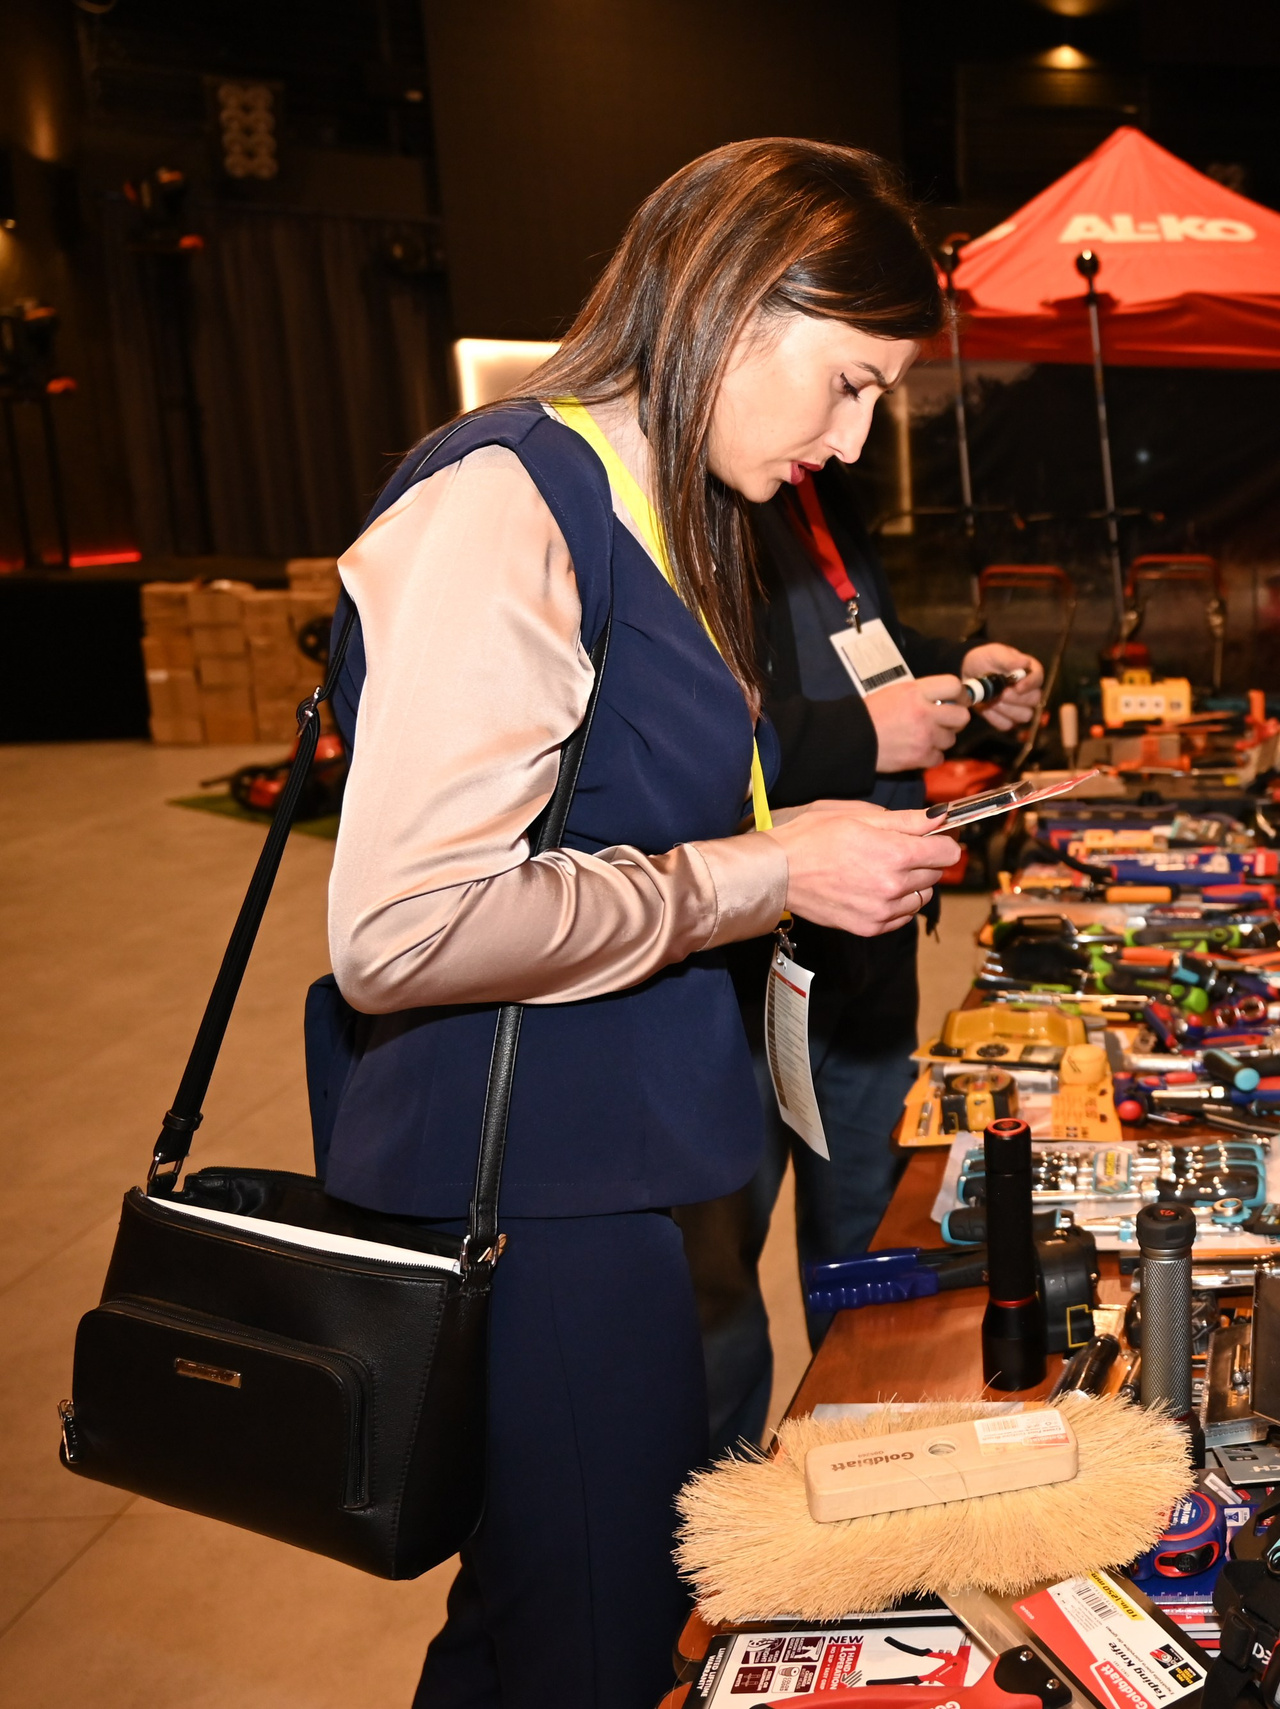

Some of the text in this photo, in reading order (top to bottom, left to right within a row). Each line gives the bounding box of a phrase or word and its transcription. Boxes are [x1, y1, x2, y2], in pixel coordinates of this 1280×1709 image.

[830, 1451, 915, 1472] Goldblatt
[828, 1635, 864, 1644] NEW
[840, 1645, 857, 1653] 1
[830, 1646, 836, 1654] NO
[700, 1647, 726, 1697] LIMITED LIFETIME
[830, 1653, 847, 1690] OPERATION
[843, 1652, 855, 1672] HAND
[1108, 1642, 1167, 1700] Taping Knife
[696, 1655, 716, 1690] WARRANTY
[823, 1667, 831, 1678] EASY
[1176, 1673, 1185, 1682] PRO
[819, 1679, 827, 1690] GRIP
[1100, 1664, 1149, 1709] Goldblatt
